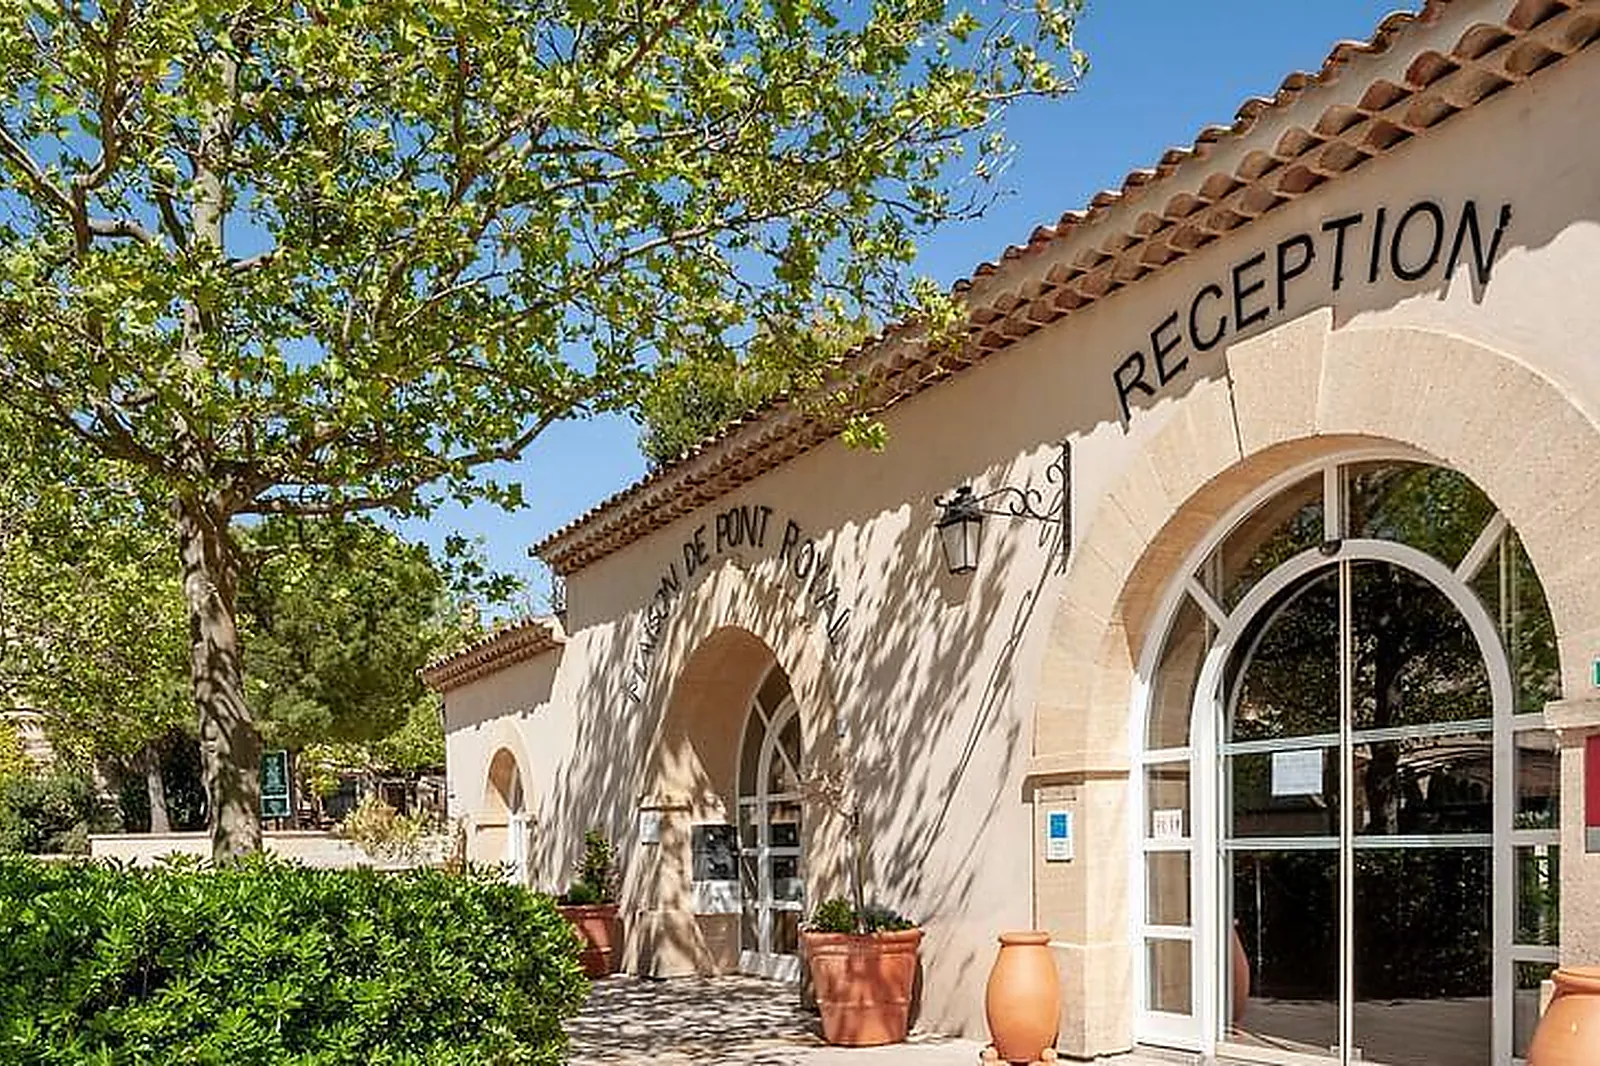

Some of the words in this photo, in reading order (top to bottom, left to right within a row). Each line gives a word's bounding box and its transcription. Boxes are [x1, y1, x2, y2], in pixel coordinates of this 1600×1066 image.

[1112, 200, 1512, 424] RECEPTION
[683, 524, 709, 577] DE
[716, 505, 773, 553] PONT
